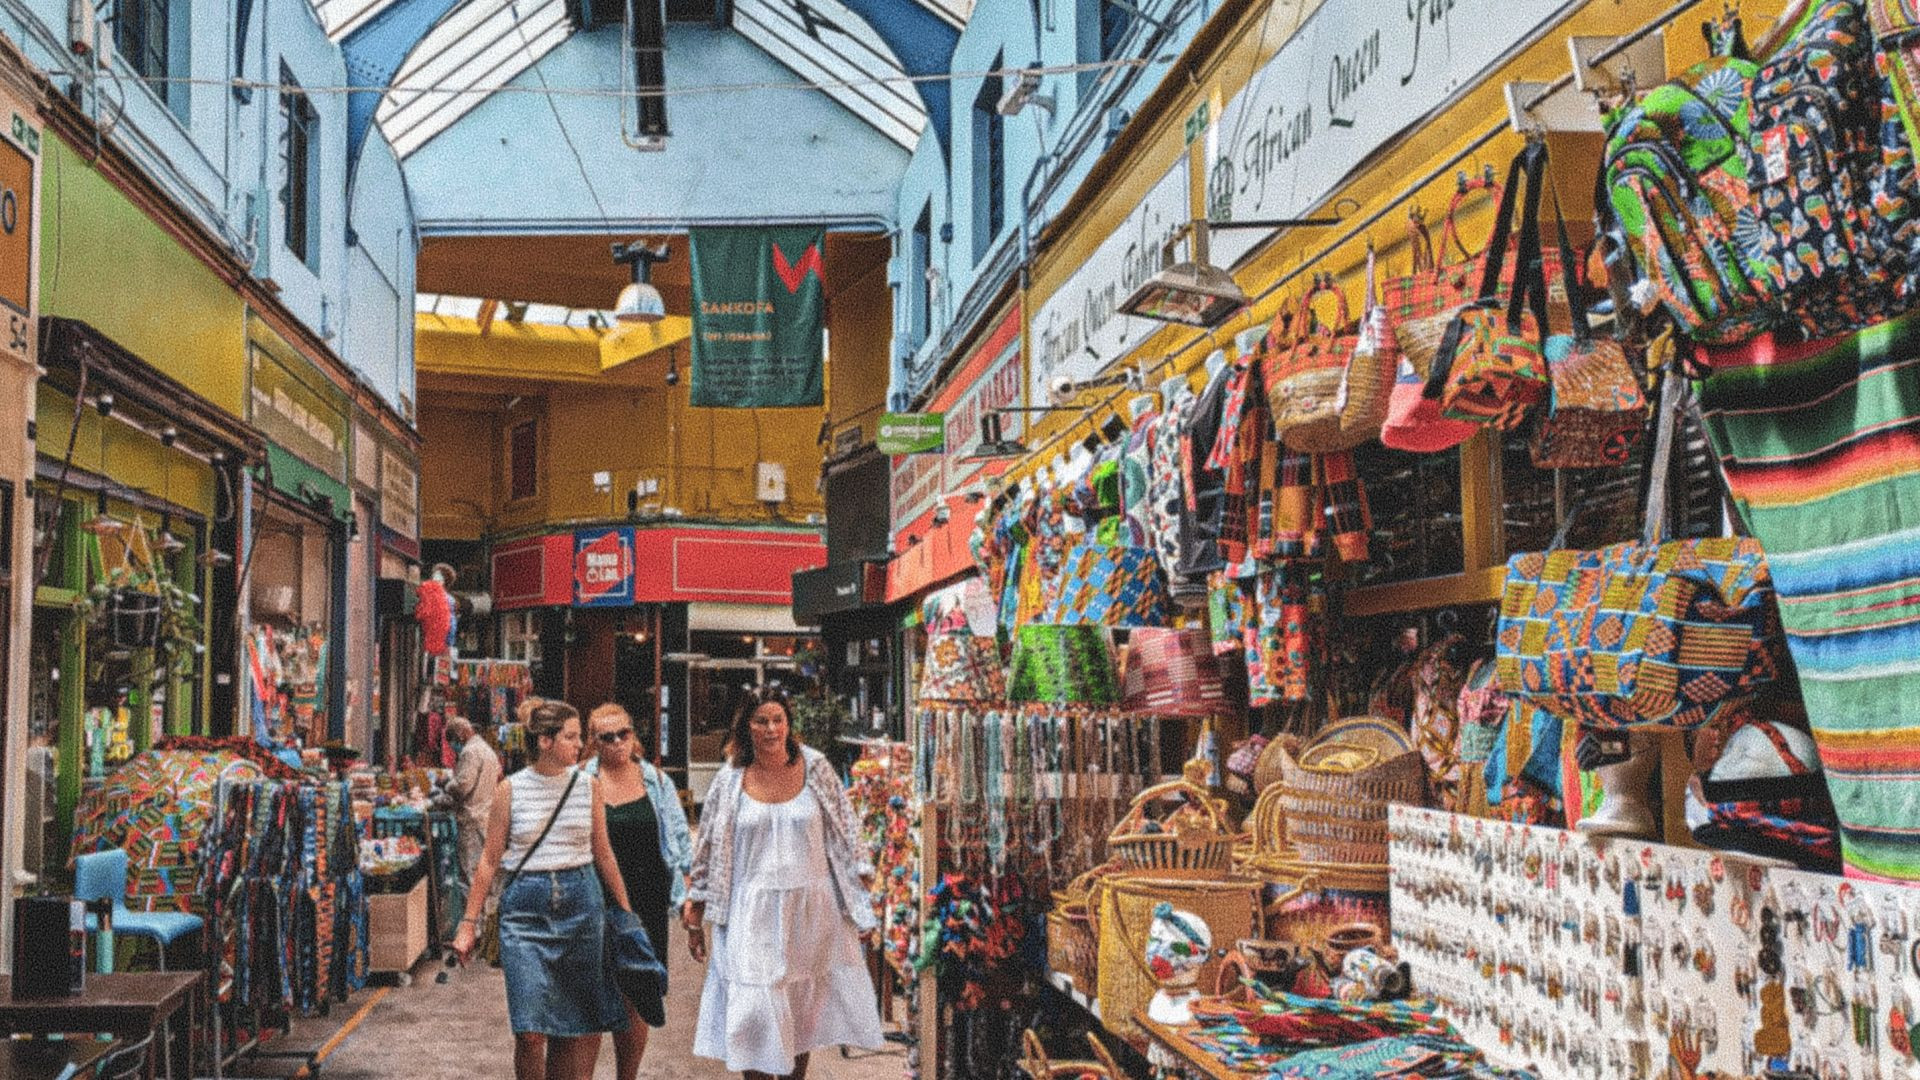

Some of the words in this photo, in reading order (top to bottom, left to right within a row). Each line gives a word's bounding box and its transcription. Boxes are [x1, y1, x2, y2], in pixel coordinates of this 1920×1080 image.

[1240, 103, 1313, 212] African
[1327, 28, 1380, 129] Queen
[700, 301, 775, 314] SANKOFA
[1038, 310, 1081, 384] African
[1083, 280, 1116, 360] Queen
[587, 553, 617, 566] Mama
